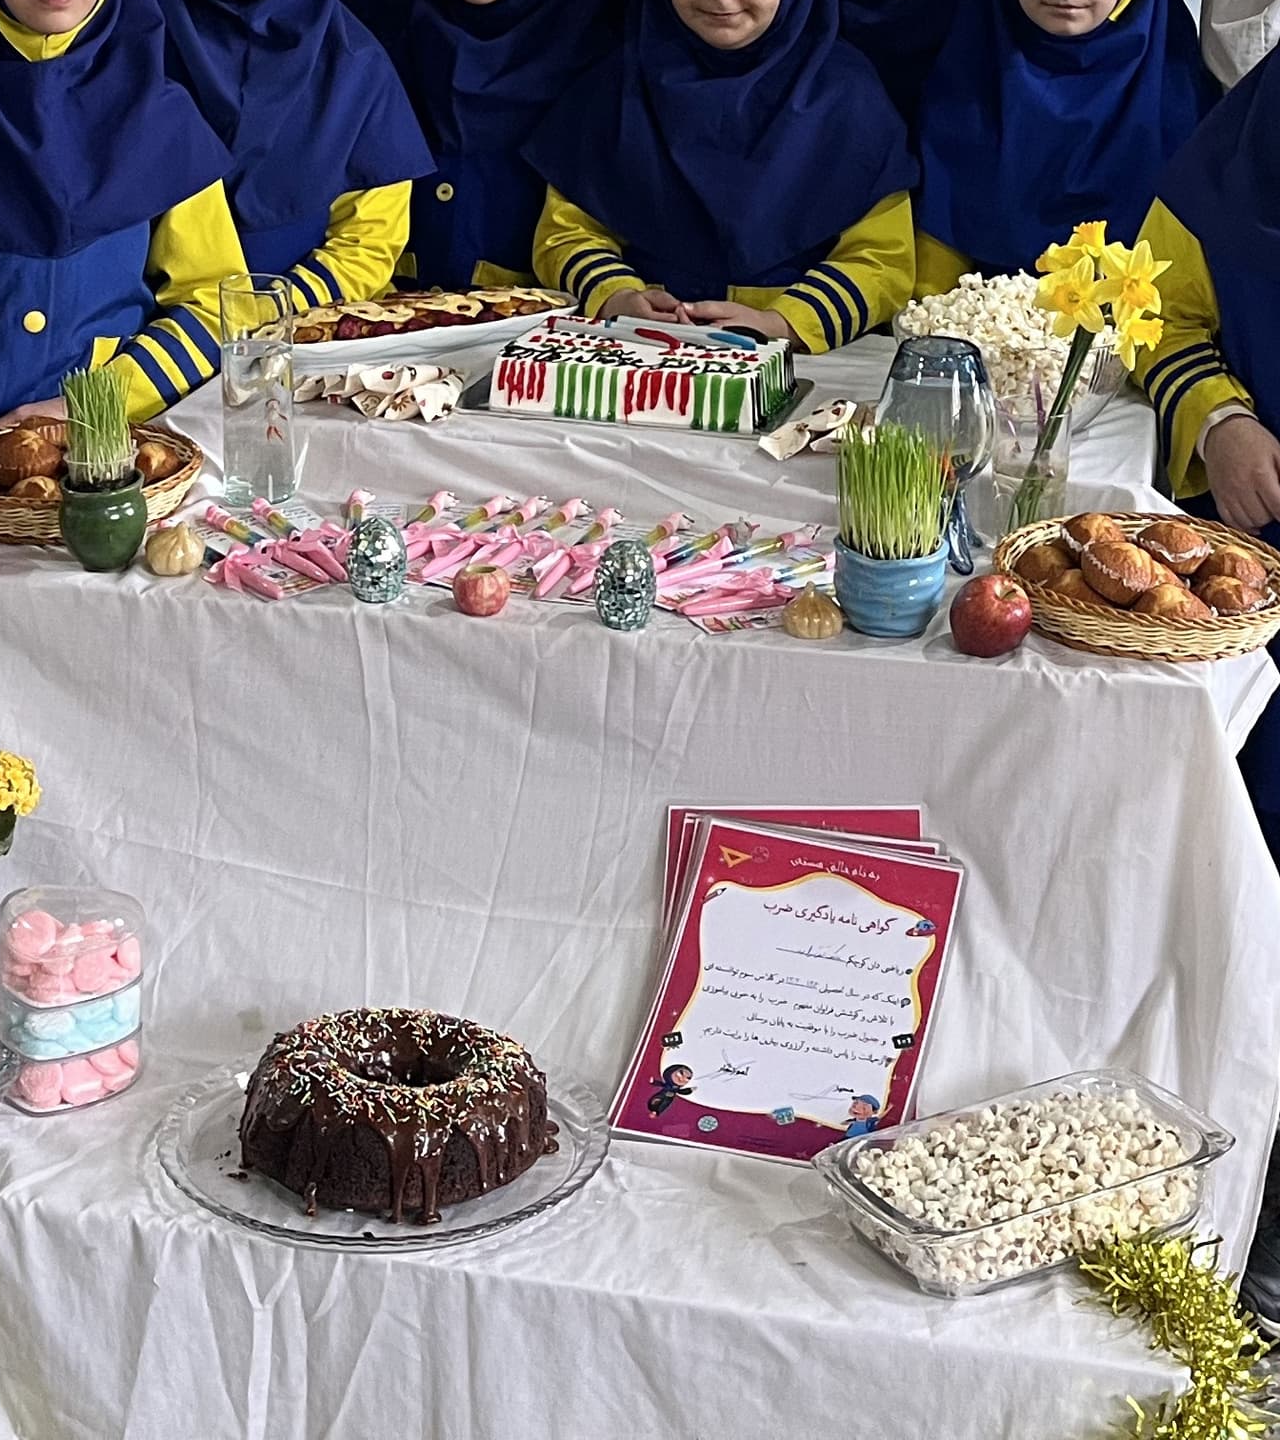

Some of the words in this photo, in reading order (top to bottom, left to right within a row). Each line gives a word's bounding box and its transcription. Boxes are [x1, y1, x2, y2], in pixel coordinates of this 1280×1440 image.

[851, 865, 866, 879] نام
[763, 901, 794, 916] ضرب
[795, 905, 836, 924] یادگیری
[838, 912, 858, 926] نامه
